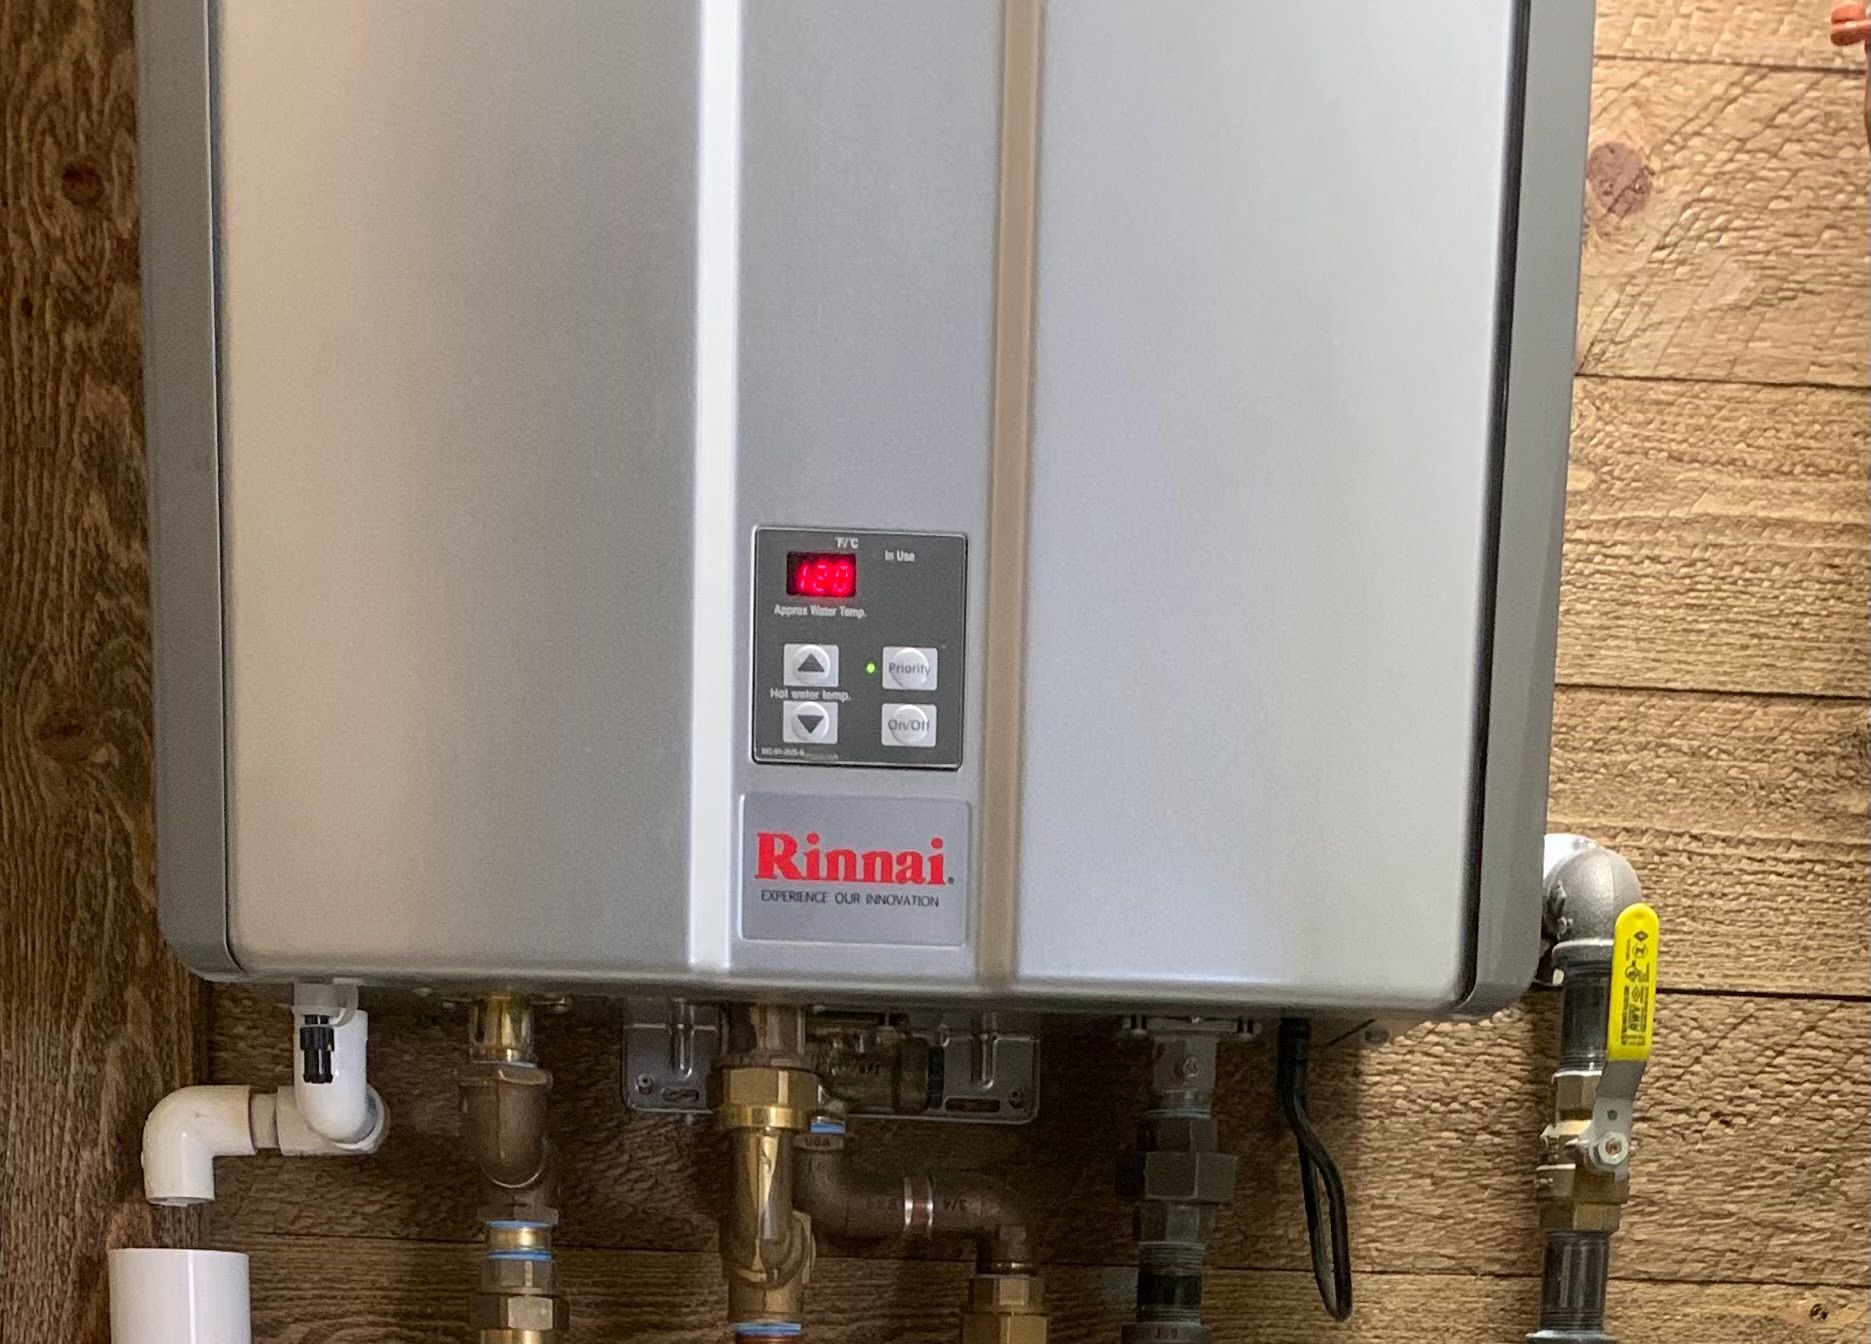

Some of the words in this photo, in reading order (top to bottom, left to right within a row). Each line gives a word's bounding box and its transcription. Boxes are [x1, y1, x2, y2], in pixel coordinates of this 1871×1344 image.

[885, 550, 894, 561] In
[897, 551, 916, 562] Use
[799, 563, 849, 593] 120
[888, 662, 932, 676] Priority
[791, 690, 820, 700] water
[888, 719, 930, 732] On/Off
[754, 832, 946, 886] Rinnai
[760, 889, 828, 904] EXPERIENCE
[834, 892, 861, 905] OUR
[866, 893, 939, 908] INNOVATION
